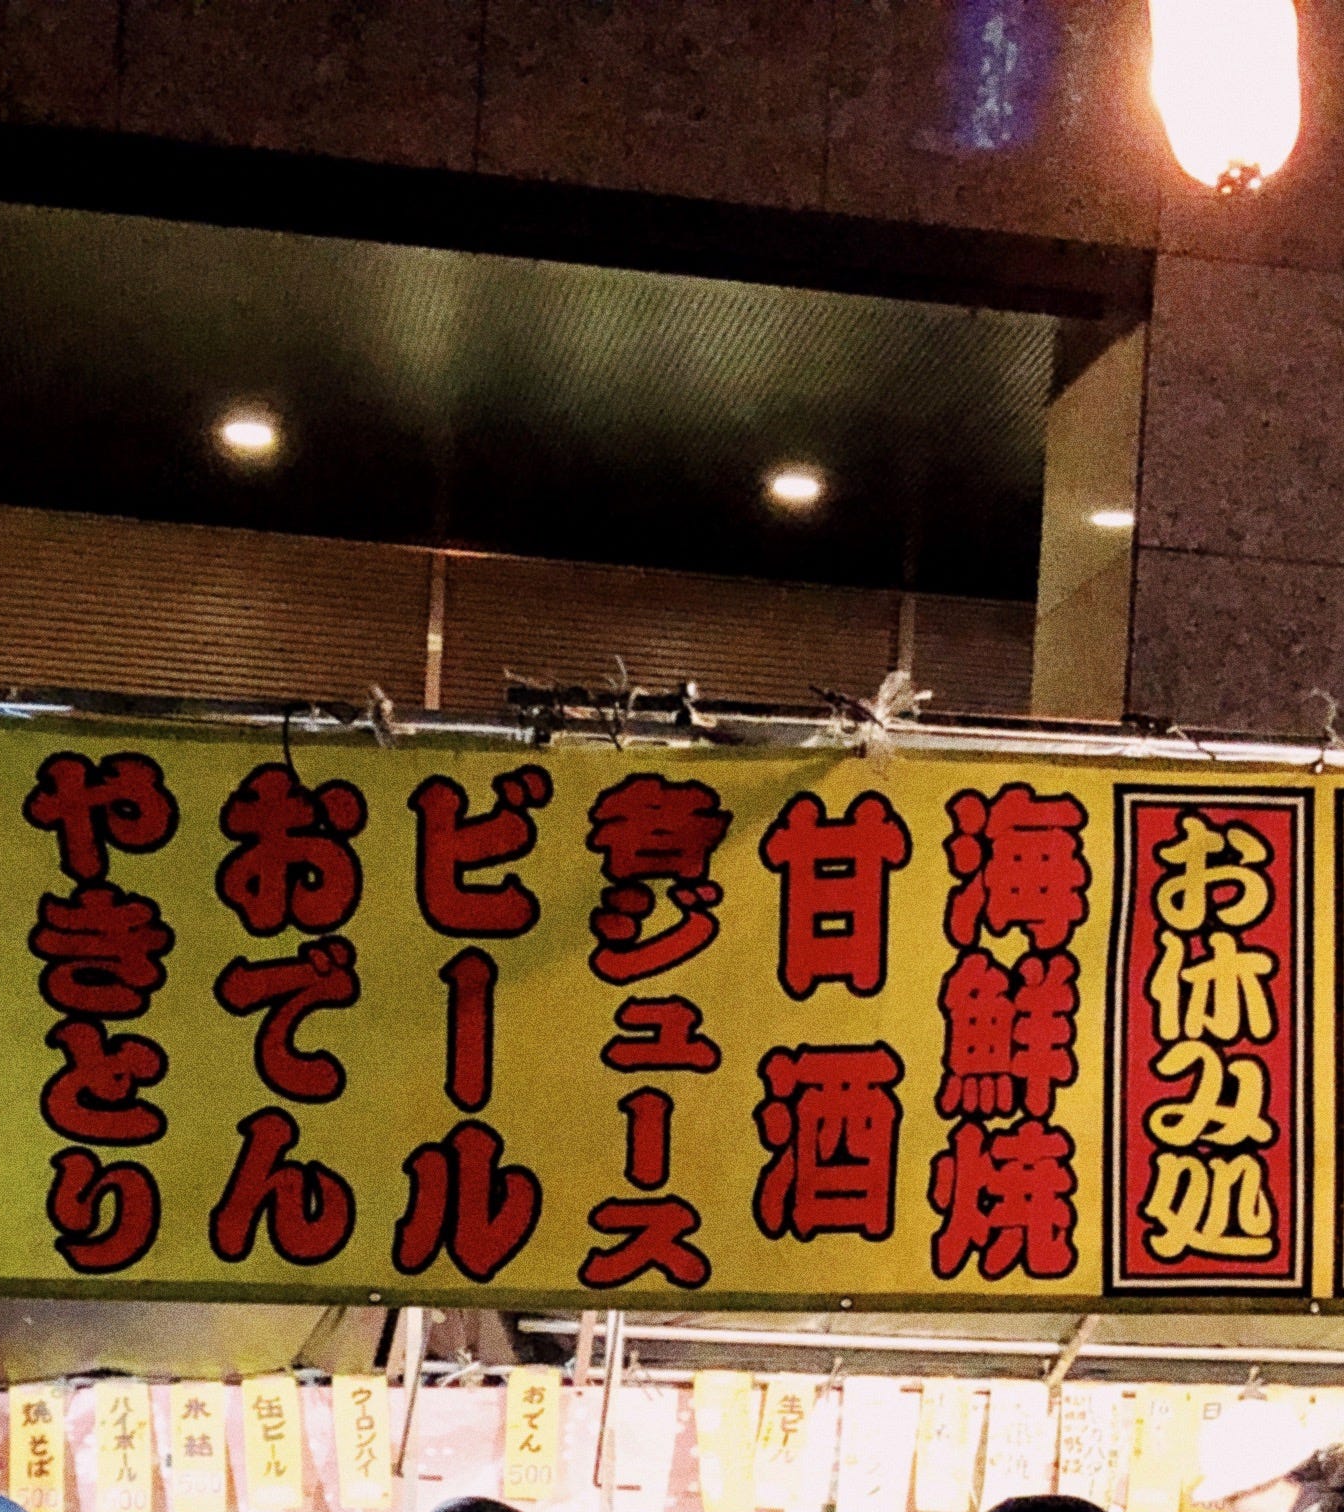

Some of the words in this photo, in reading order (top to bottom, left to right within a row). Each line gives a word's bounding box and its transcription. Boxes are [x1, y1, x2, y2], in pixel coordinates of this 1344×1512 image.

[22, 750, 181, 1275] やきとり
[208, 762, 368, 1266] おでん
[392, 765, 554, 1283] ビール
[753, 790, 913, 1243] 甘酒
[929, 780, 1089, 1282] 海鮮焼
[1143, 813, 1283, 1264] お休み処
[109, 1395, 139, 1484] ハイボール
[180, 1395, 215, 1458] 氷結
[251, 1393, 288, 1479] 缶ビール
[349, 1386, 378, 1478] ウーロンハイ
[518, 1384, 548, 1455] おでん
[768, 1391, 806, 1465] 生ビール
[508, 1463, 553, 1487] 500
